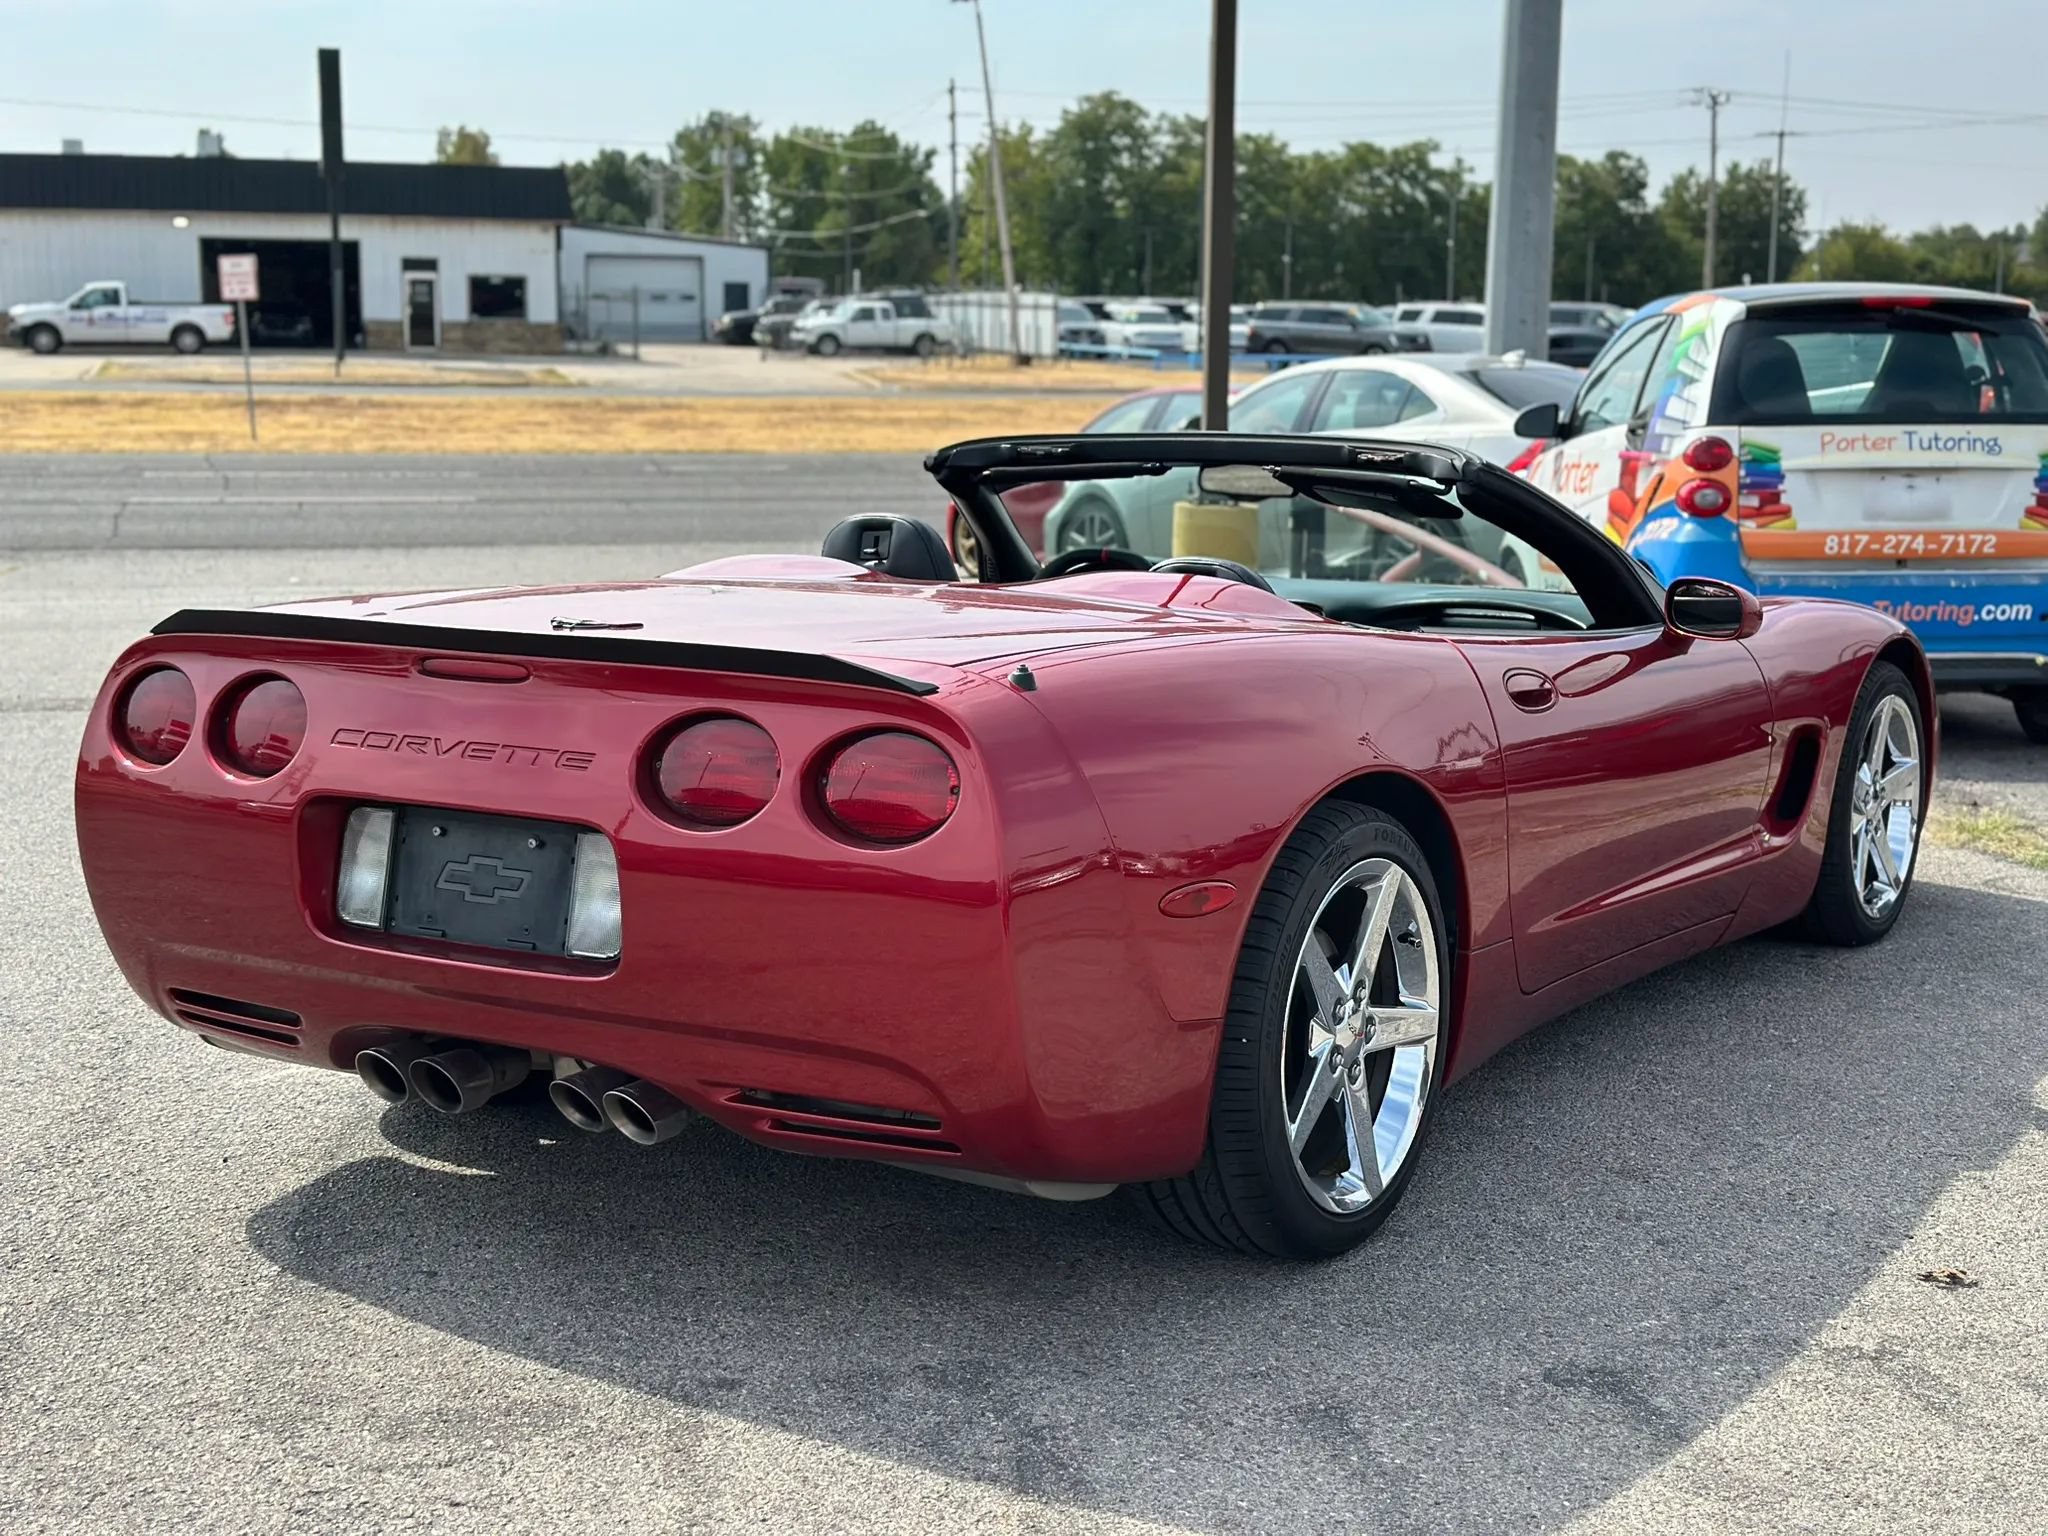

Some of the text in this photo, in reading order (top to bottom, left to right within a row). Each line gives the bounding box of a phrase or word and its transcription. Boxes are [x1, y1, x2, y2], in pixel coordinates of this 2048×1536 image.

[1820, 430, 2003, 456] Porter Tutoring
[1823, 533, 1998, 555] 817-274-7172
[330, 728, 597, 771] CORVETTE
